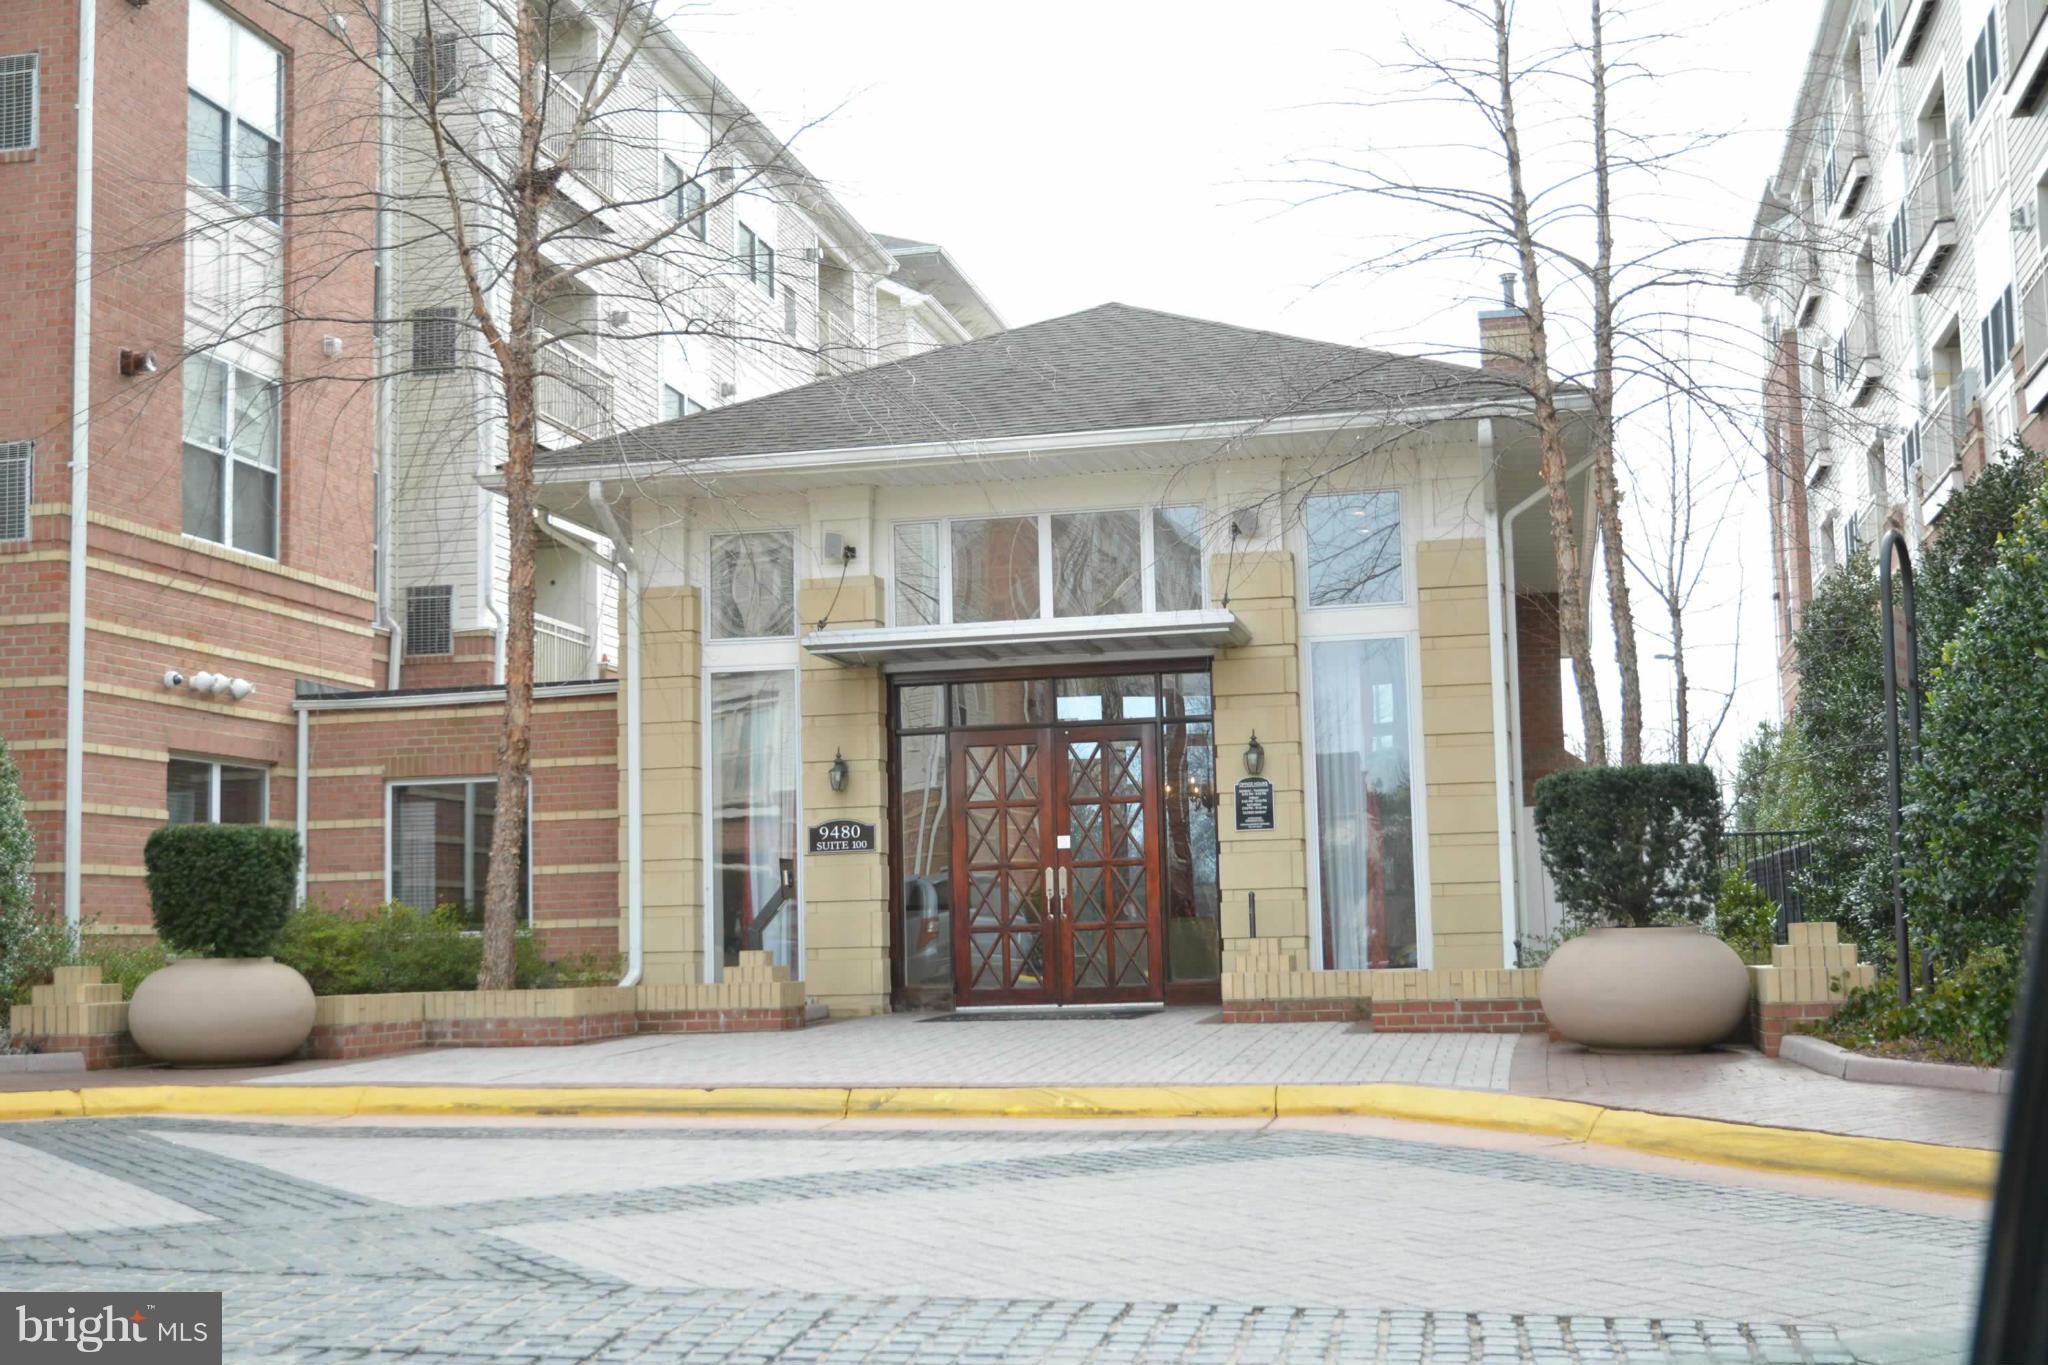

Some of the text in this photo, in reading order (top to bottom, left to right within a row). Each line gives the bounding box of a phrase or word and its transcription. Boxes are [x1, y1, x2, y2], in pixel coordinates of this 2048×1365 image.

[819, 824, 861, 840] 9480
[816, 840, 868, 851] SUITE 100
